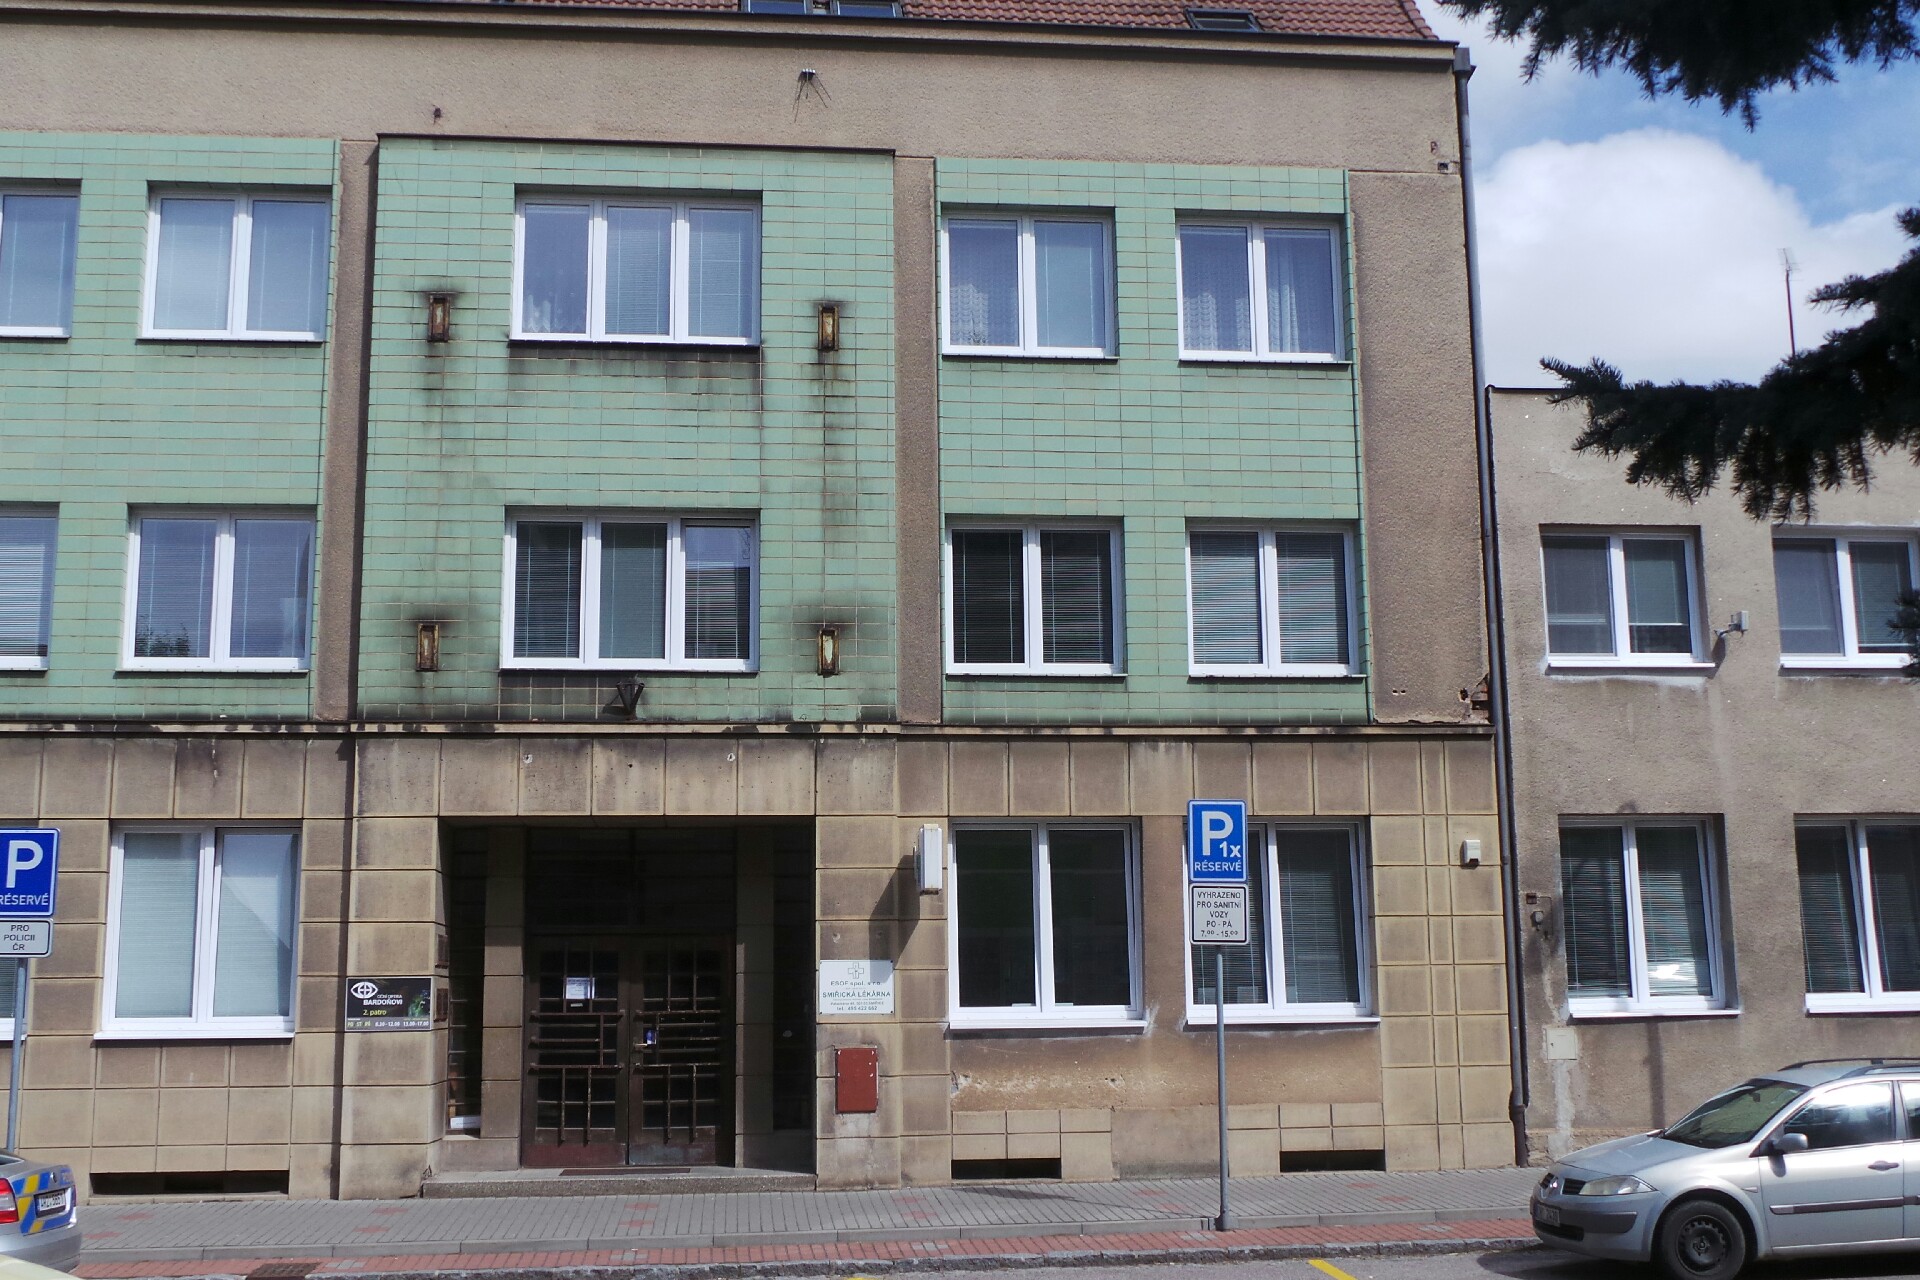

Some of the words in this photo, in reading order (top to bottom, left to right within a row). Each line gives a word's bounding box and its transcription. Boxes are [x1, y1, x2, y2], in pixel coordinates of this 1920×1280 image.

[1201, 811, 1234, 856] P
[1219, 841, 1242, 858] 1x
[6, 840, 44, 888] P
[1194, 860, 1243, 872] RÉSERVÉ
[1197, 891, 1241, 899] VYHRAZENO
[0, 893, 49, 906] RÉSERVÉ
[1213, 900, 1242, 908] SANITNÍ
[10, 924, 30, 932] PRO
[1206, 920, 1217, 928] PO
[3, 934, 36, 942] POLICII
[12, 943, 25, 951] ČR
[822, 990, 856, 998] SMIŘICKÁ
[857, 990, 891, 998] LÉKÁRNA
[363, 998, 403, 1006] BARDOŇOVI
[369, 1009, 387, 1017] patro
